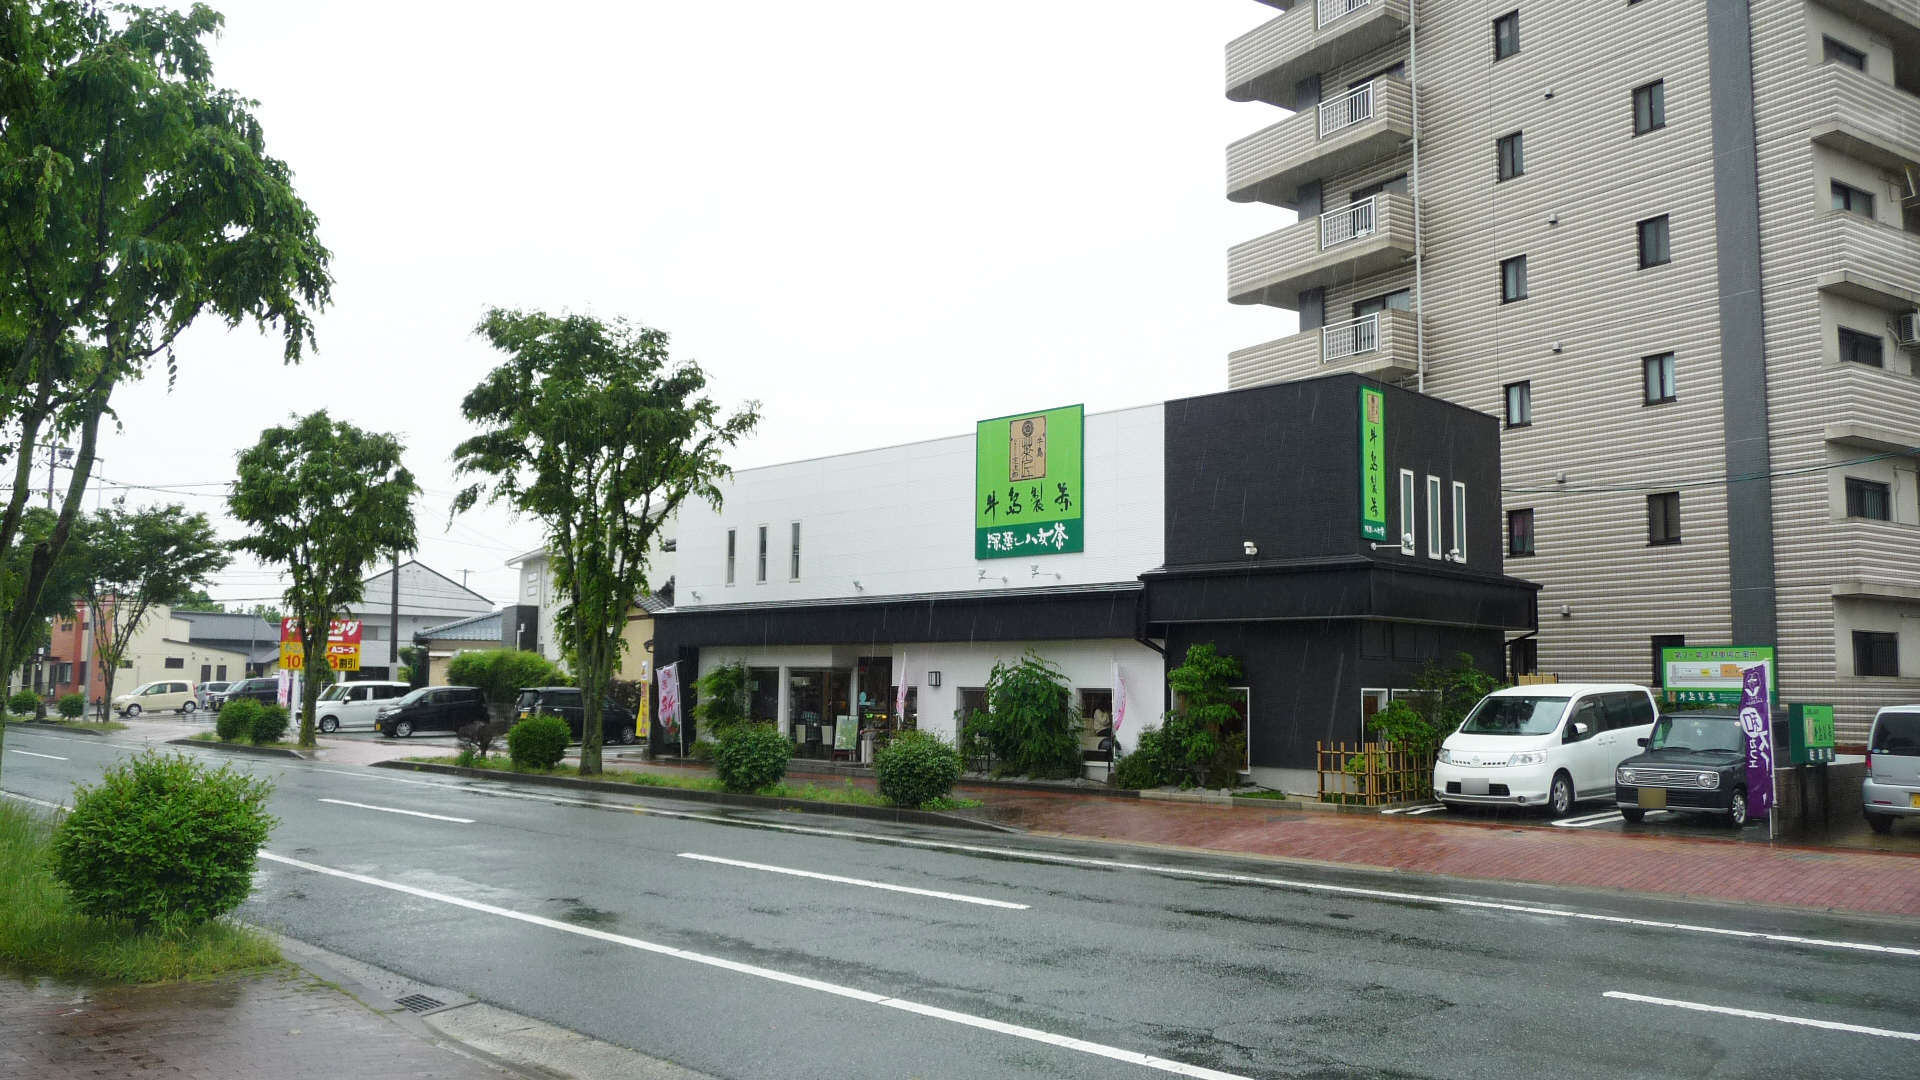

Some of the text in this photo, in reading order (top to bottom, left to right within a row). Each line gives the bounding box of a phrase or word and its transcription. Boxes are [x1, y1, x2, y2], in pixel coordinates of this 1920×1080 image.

[1369, 426, 1379, 518] 牛島製茶
[984, 481, 1072, 524] 牛島製茶
[987, 522, 1069, 551] 深蒸し八女茶
[326, 654, 356, 669] 3割引
[331, 646, 355, 654] Aコース
